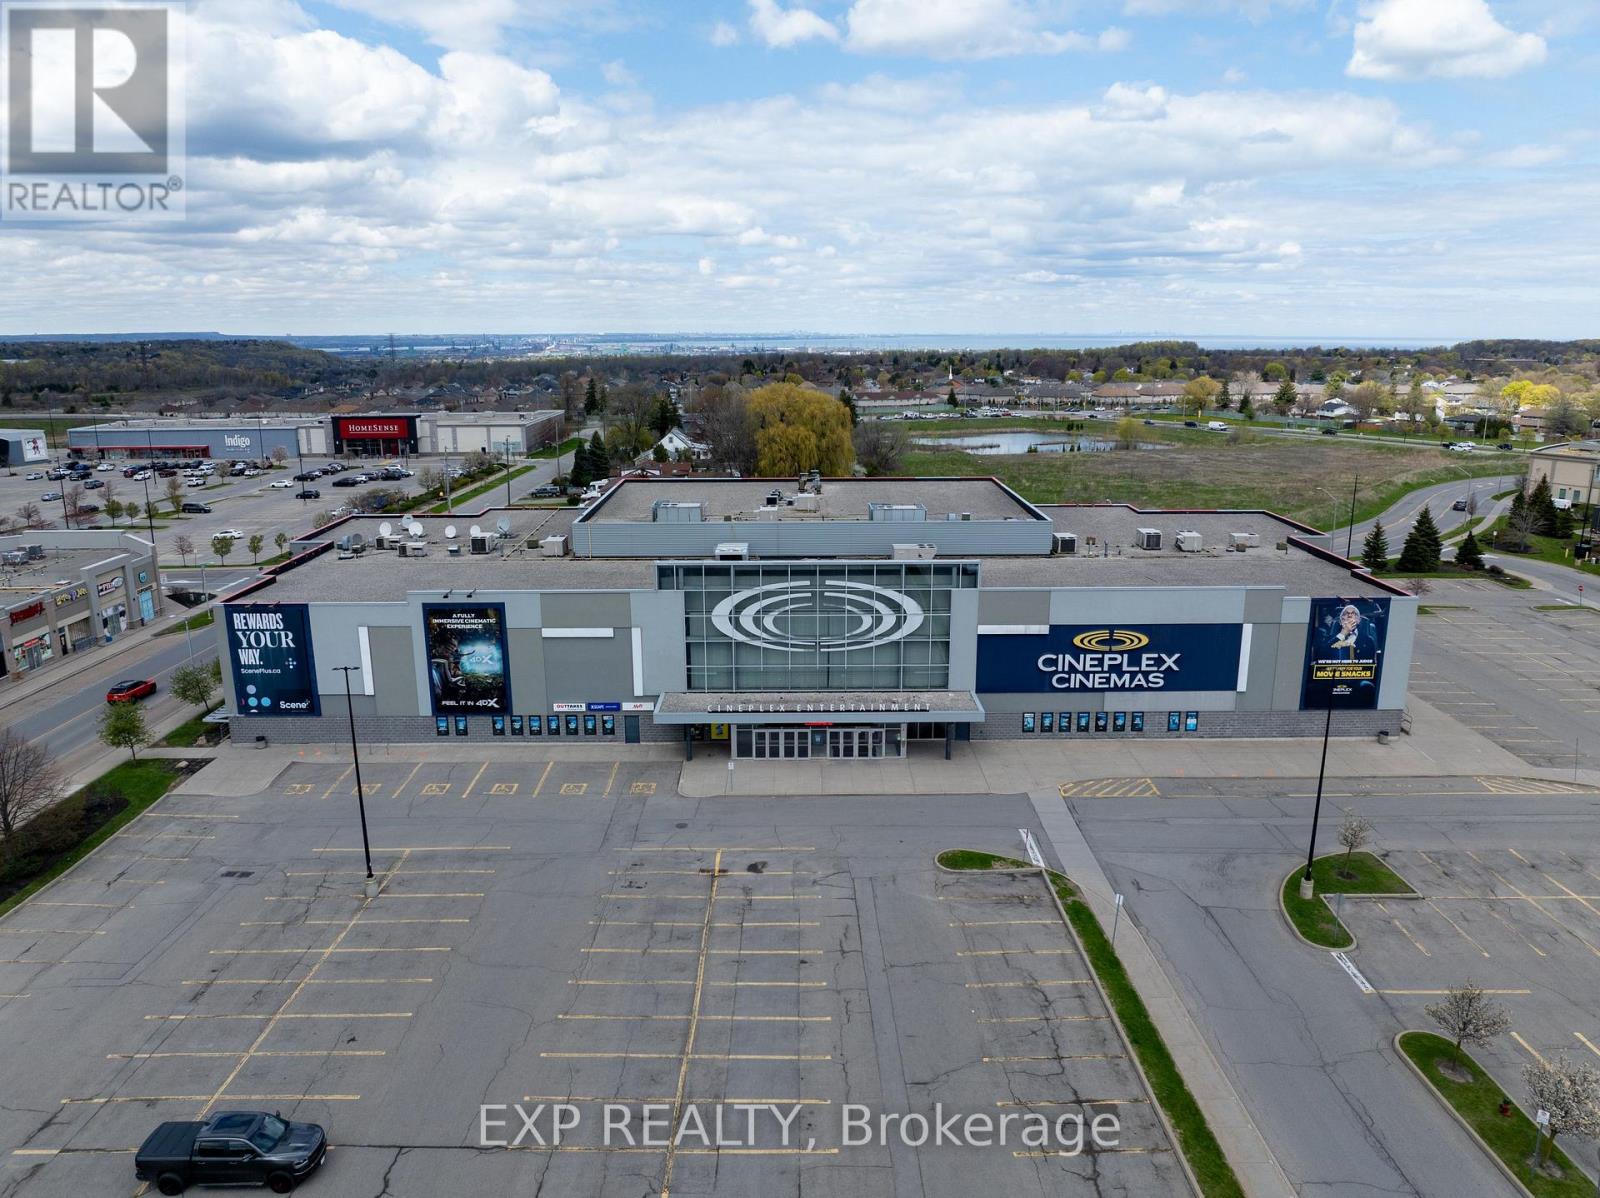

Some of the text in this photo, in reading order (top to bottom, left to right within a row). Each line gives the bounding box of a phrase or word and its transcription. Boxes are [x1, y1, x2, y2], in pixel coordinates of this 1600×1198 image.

[224, 434, 250, 448] Indigo
[233, 613, 283, 630] REWARDS
[236, 631, 296, 648] YOUR
[238, 649, 264, 665] WAY.
[1037, 653, 1182, 672] CINEPLEX
[1051, 673, 1165, 689] CINEMAS
[475, 697, 500, 708] 4DX
[707, 703, 931, 712] CINEPLEX ENTERTAINMENT
